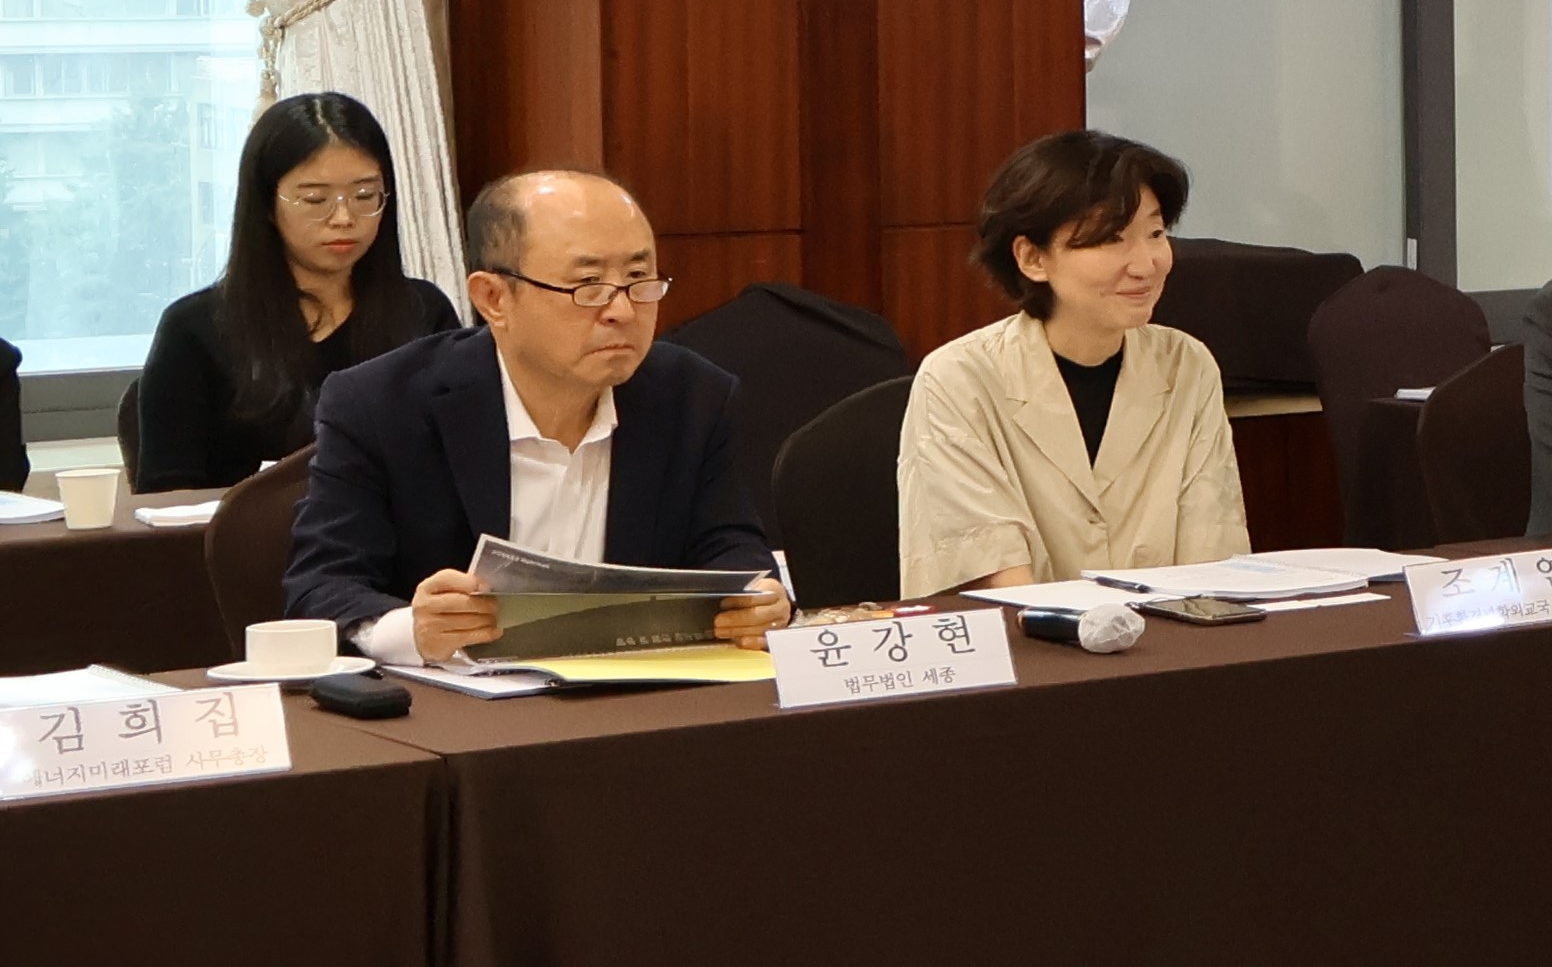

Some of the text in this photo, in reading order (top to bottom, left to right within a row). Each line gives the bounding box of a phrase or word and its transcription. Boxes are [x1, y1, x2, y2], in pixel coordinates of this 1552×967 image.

[844, 666, 956, 694] 법무법인 세종
[185, 745, 269, 771] 사무총장
